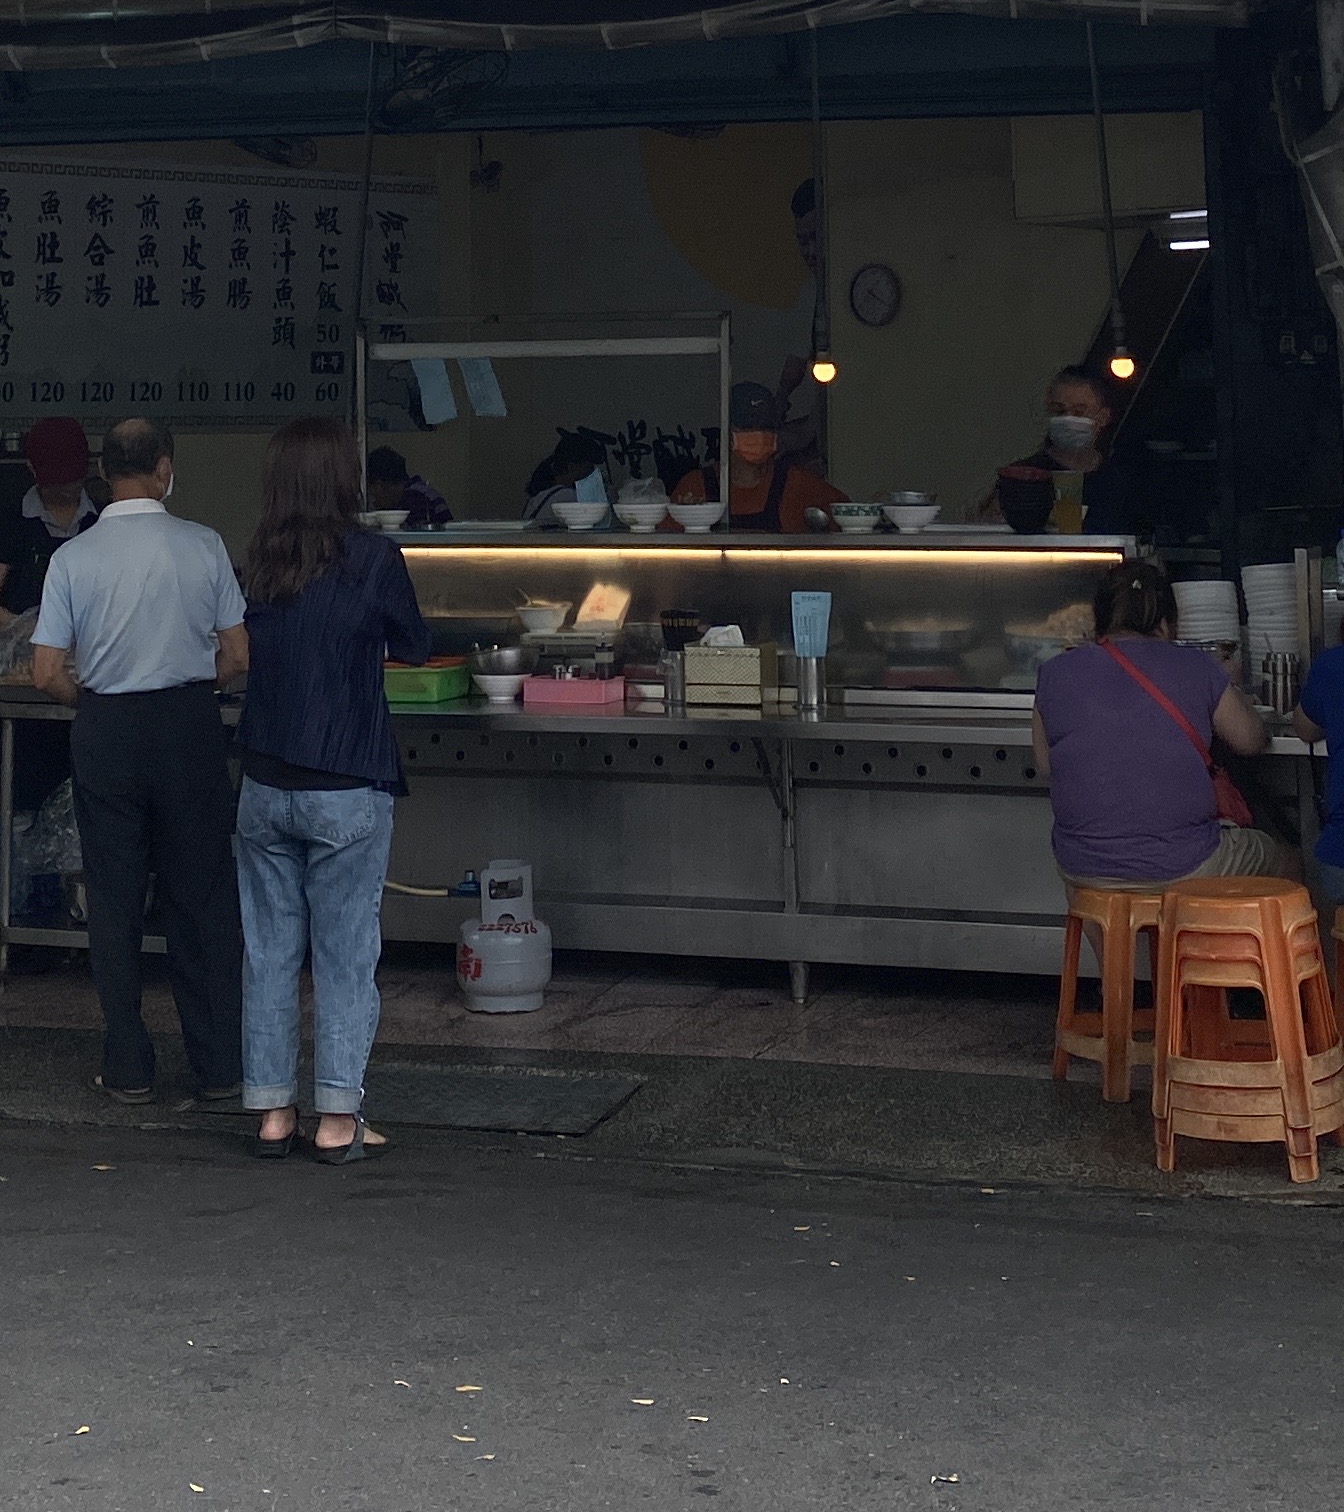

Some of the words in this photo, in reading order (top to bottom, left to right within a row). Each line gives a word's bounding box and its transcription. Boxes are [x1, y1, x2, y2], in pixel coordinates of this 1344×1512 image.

[34, 190, 63, 308] 魚肚湯
[83, 193, 115, 309] 綜合湯
[132, 193, 161, 309] 煎魚肚
[180, 196, 207, 310] 魚皮湯
[313, 204, 343, 313] 蝦仁飯
[316, 324, 340, 343] 50
[30, 381, 65, 404] 120
[80, 381, 115, 404] 120
[129, 381, 163, 403] 120
[177, 381, 209, 403] 110
[224, 381, 255, 403] 110
[270, 381, 296, 402] 40
[315, 381, 340, 402] 60
